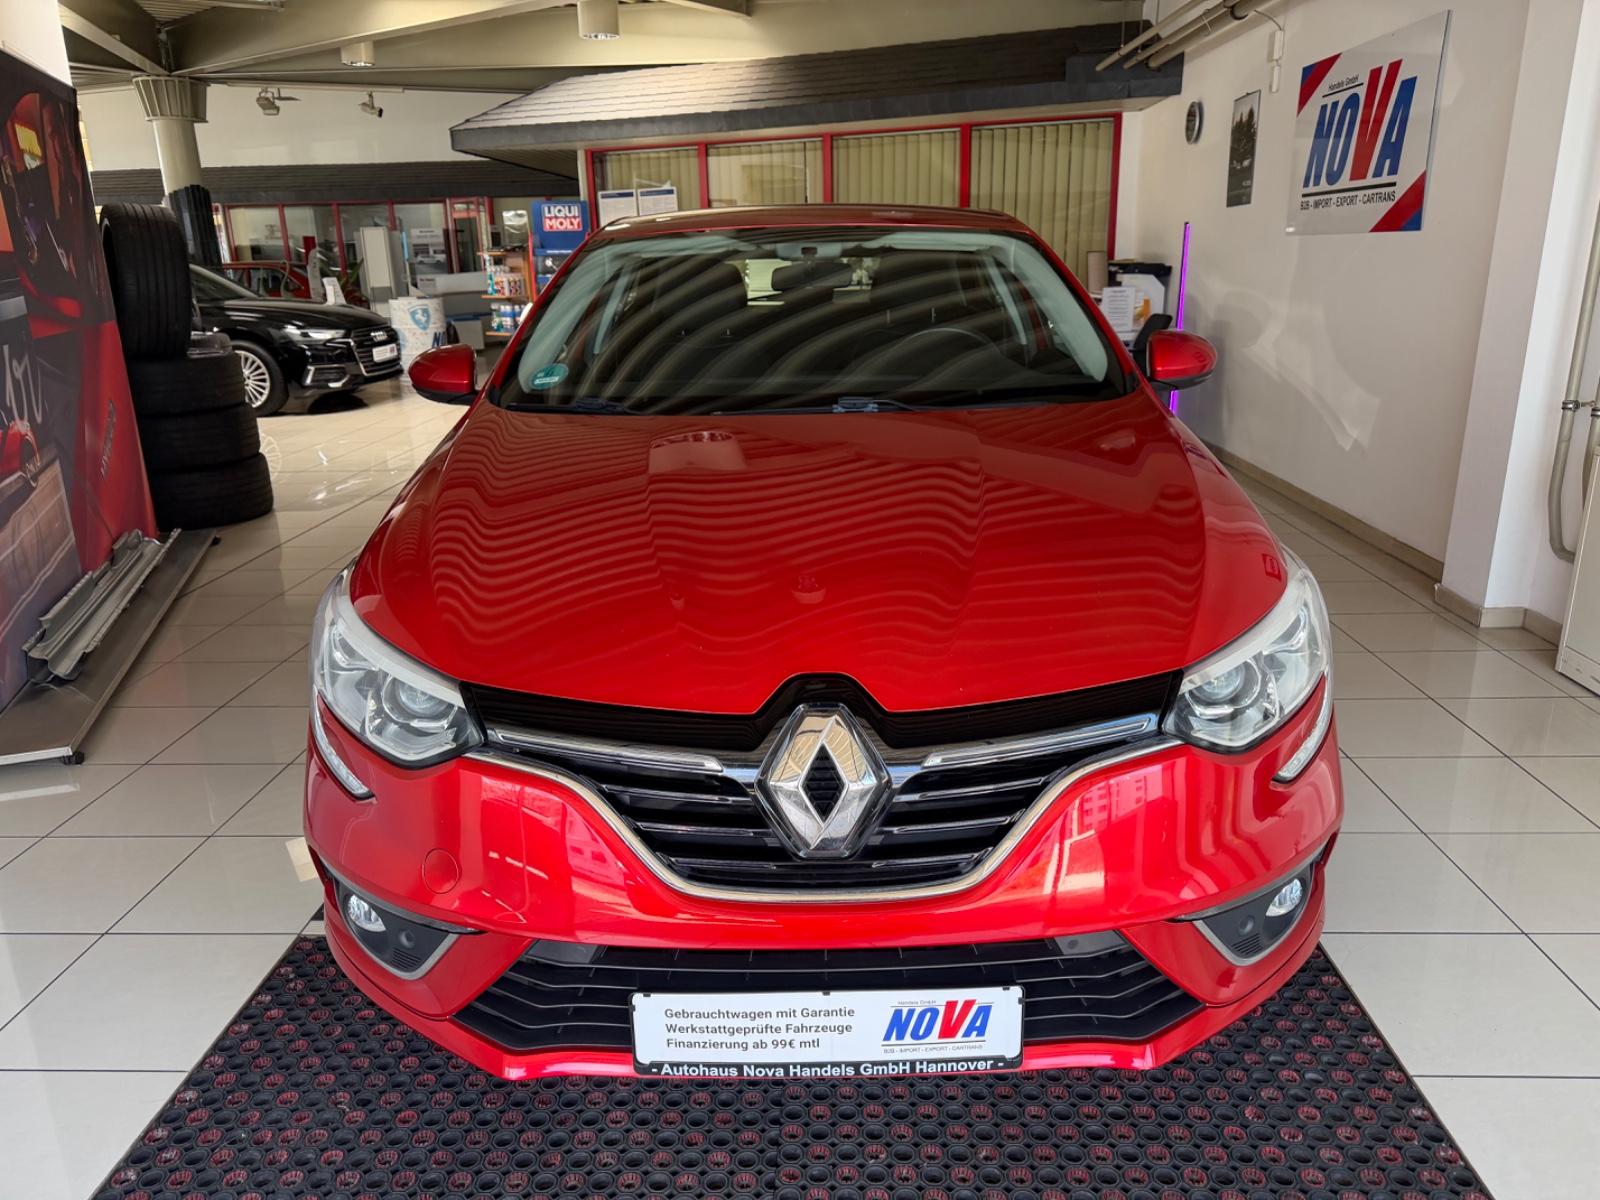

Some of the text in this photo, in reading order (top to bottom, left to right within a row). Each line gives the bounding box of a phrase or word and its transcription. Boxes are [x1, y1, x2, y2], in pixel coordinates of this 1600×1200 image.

[1302, 58, 1418, 188] NOVA
[1313, 197, 1332, 209] IMPORT
[1335, 194, 1358, 207] EXPORT
[1361, 190, 1396, 205] CARTRANS
[544, 205, 579, 217] LIQUI
[544, 218, 581, 229] MOLY
[664, 1006, 855, 1021] Gebrauchtwagen mit Garantie
[882, 999, 993, 1041] NOVA
[665, 1022, 853, 1036] Werkstattgeprüfte Fahrzeuge
[666, 1038, 820, 1051] Finanzierung ab 99€ mtl
[661, 1064, 738, 1076] Autohaus
[743, 1064, 784, 1077] Nova
[789, 1063, 855, 1076] Handels
[860, 1062, 912, 1075] GmbH
[916, 1060, 994, 1073] Hannover
